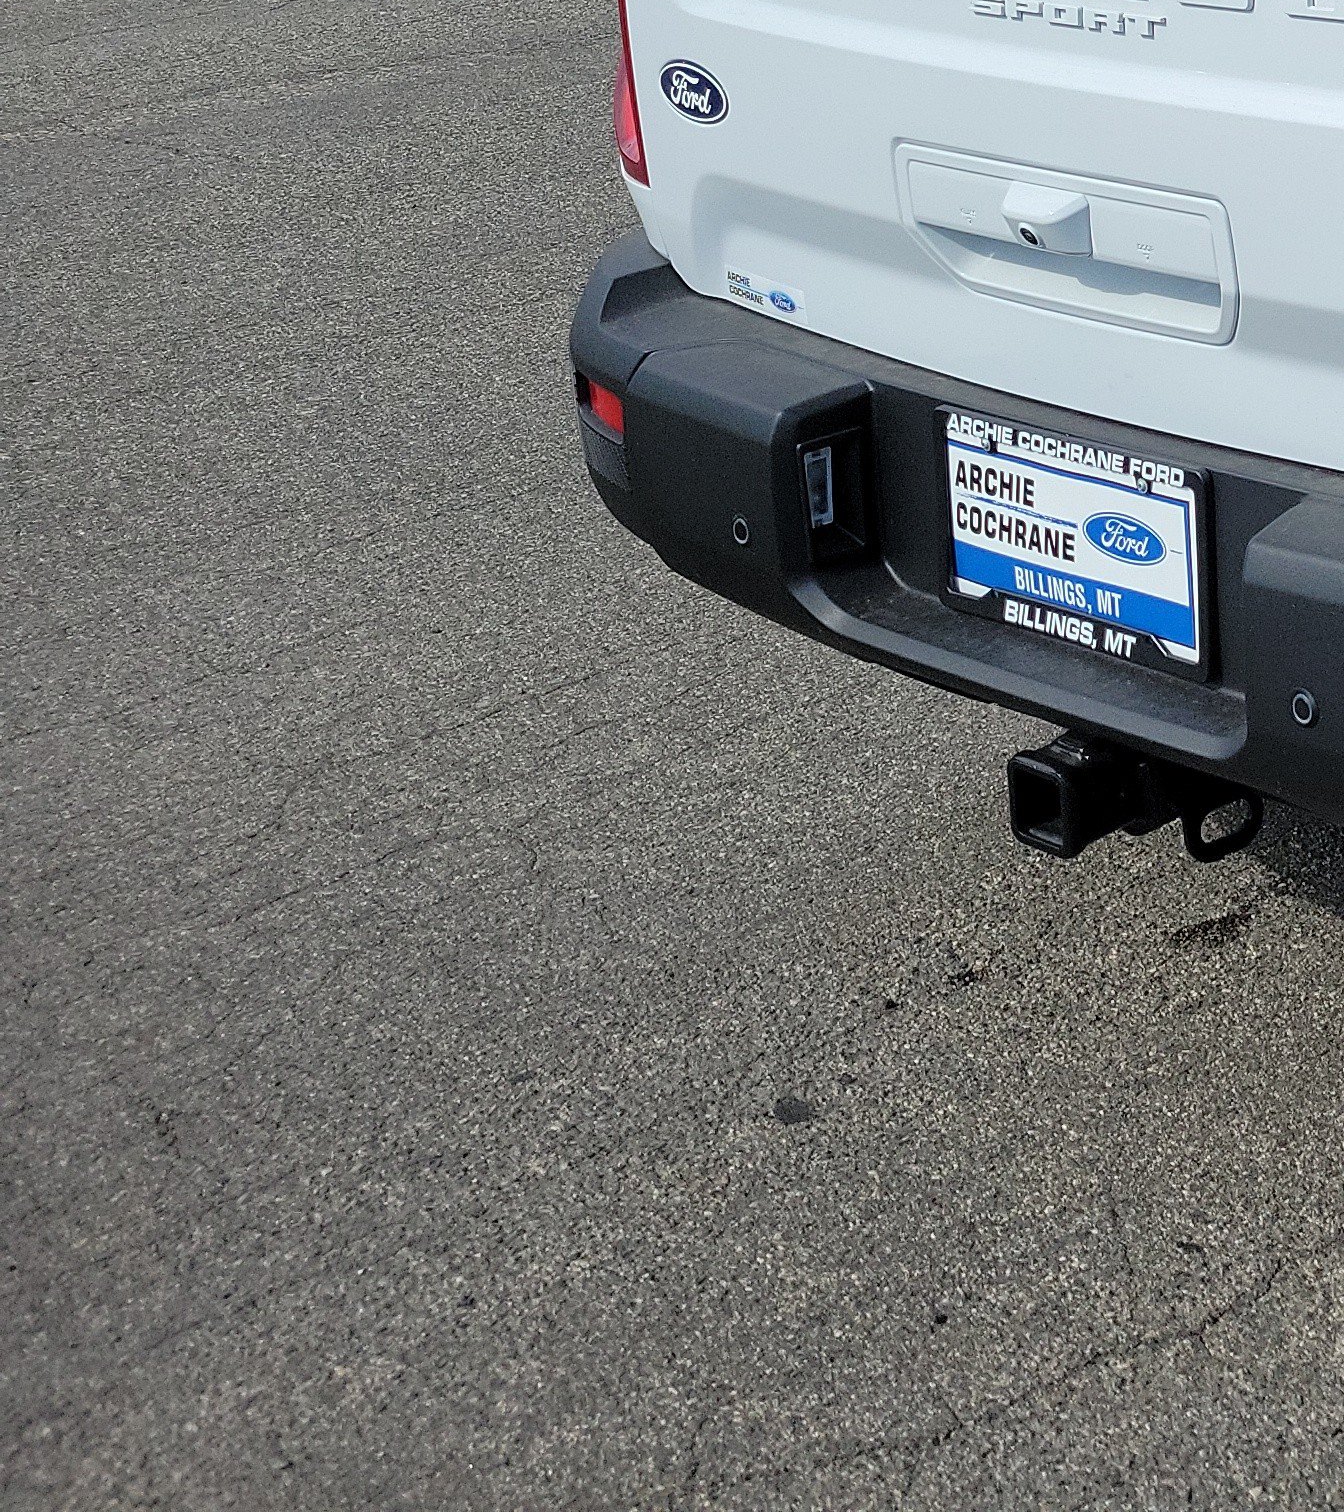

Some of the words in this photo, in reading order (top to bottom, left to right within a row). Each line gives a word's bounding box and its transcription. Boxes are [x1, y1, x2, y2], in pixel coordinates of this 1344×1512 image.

[670, 70, 712, 115] Ford
[727, 270, 751, 288] ARCHIE
[729, 284, 765, 306] COCHRANE
[947, 413, 1013, 446] ARCHIE
[1018, 431, 1125, 474] COCHRANE
[1129, 458, 1185, 488] FORD
[955, 459, 1035, 508] ARCHIE
[956, 501, 1076, 563] COCHRANE
[1101, 518, 1149, 558] Ford
[1014, 565, 1092, 615] BILLINGS,
[1097, 589, 1122, 619] MT
[1004, 600, 1097, 650] BILLINGS,
[1104, 628, 1137, 659] MT
